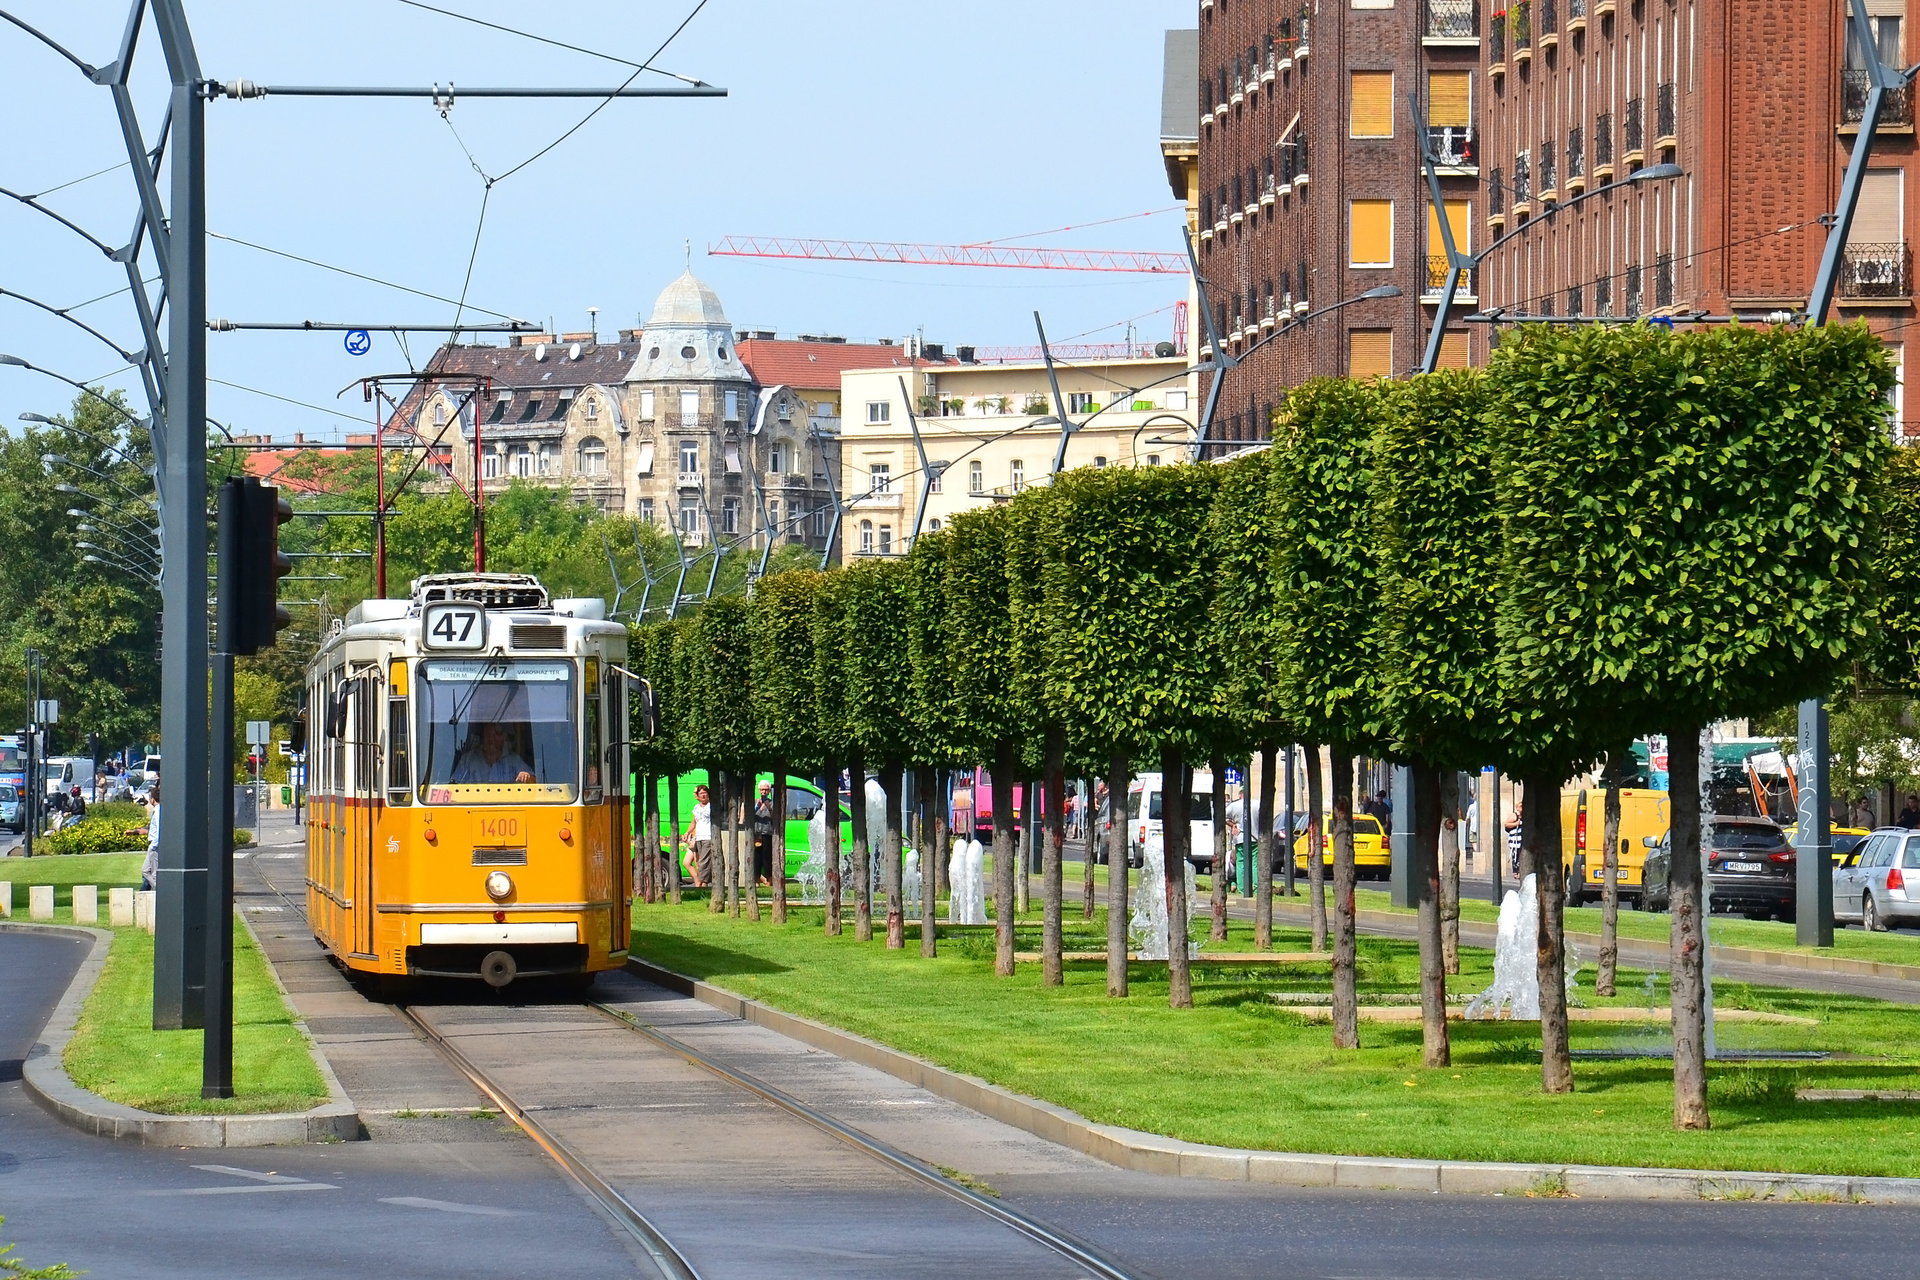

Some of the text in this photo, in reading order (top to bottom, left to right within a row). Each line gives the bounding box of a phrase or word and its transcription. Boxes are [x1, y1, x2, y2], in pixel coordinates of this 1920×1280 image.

[432, 612, 476, 642] 47
[488, 666, 508, 678] 47
[480, 818, 518, 837] 1400
